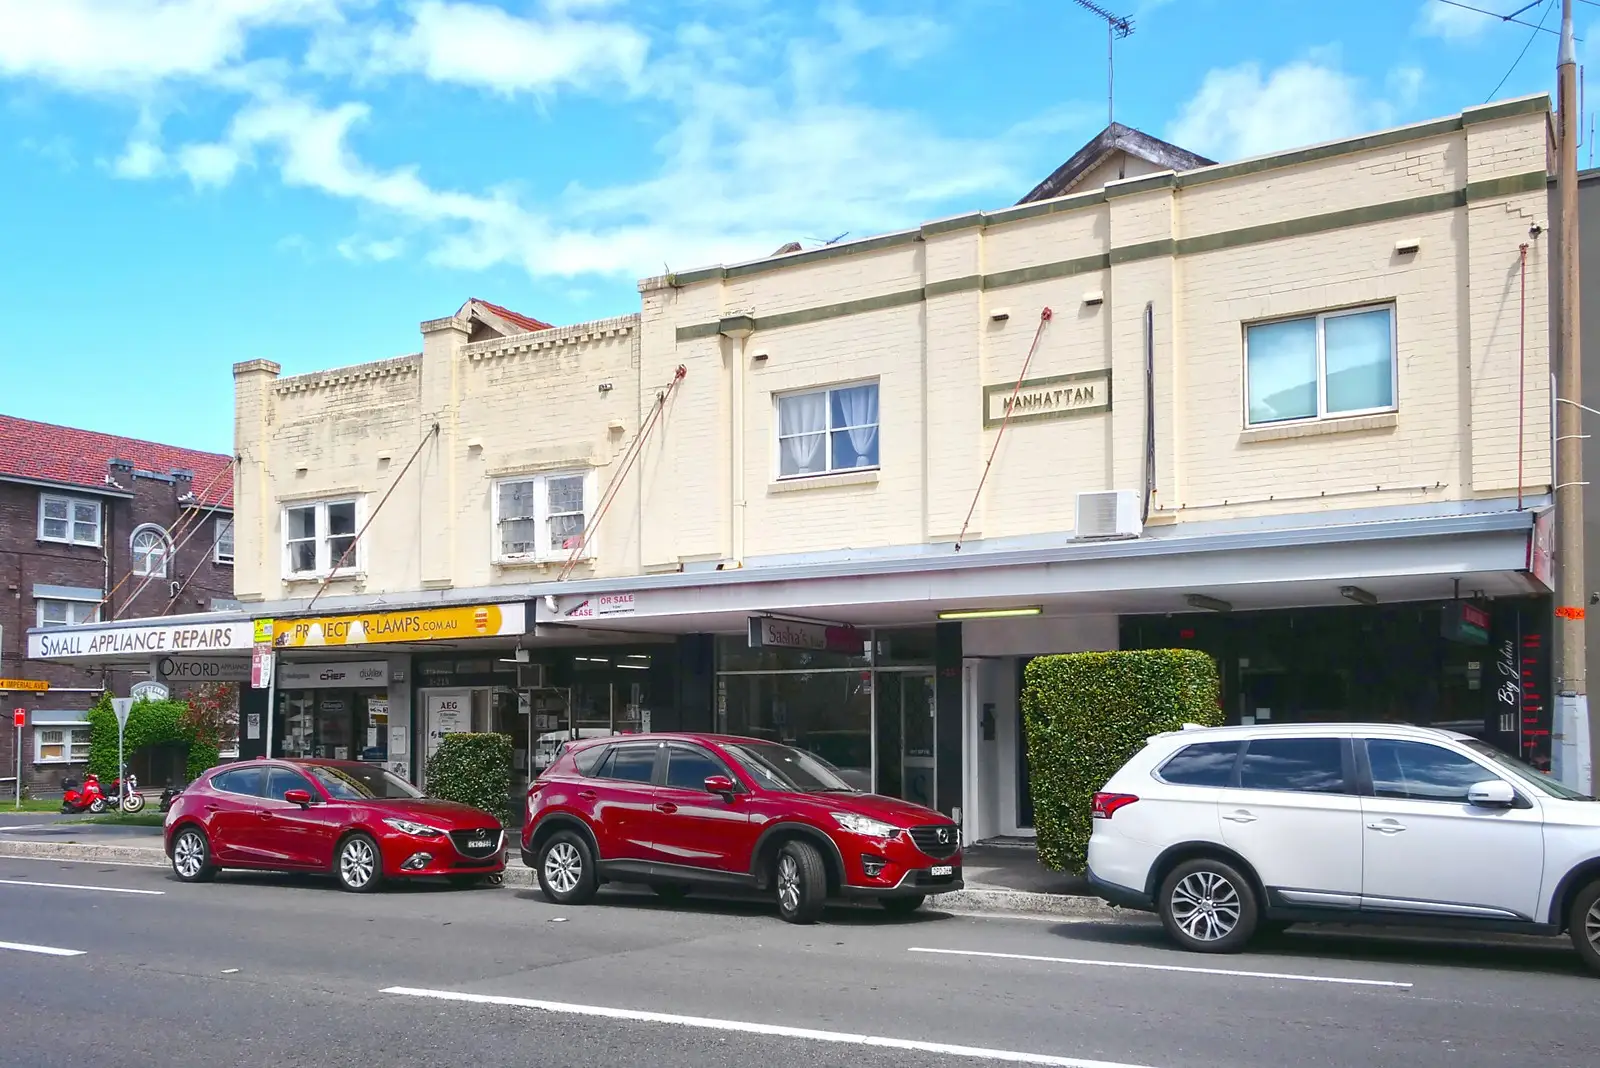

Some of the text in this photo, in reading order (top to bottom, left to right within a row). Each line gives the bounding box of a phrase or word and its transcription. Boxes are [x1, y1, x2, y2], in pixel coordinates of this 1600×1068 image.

[1003, 386, 1094, 409] MANHATTAN
[600, 595, 633, 605] OR SALE
[295, 616, 458, 638] PRJECTR-LAMPS.COM.AU
[769, 624, 808, 646] Sasha's
[41, 635, 82, 656] SMALL
[88, 632, 166, 653] APPLIANCE
[172, 628, 232, 648] REPAIRS
[159, 658, 220, 676] OXFORD
[319, 672, 346, 680] CHEF
[1496, 640, 1520, 705] Big Johns
[440, 701, 458, 710] AEG
